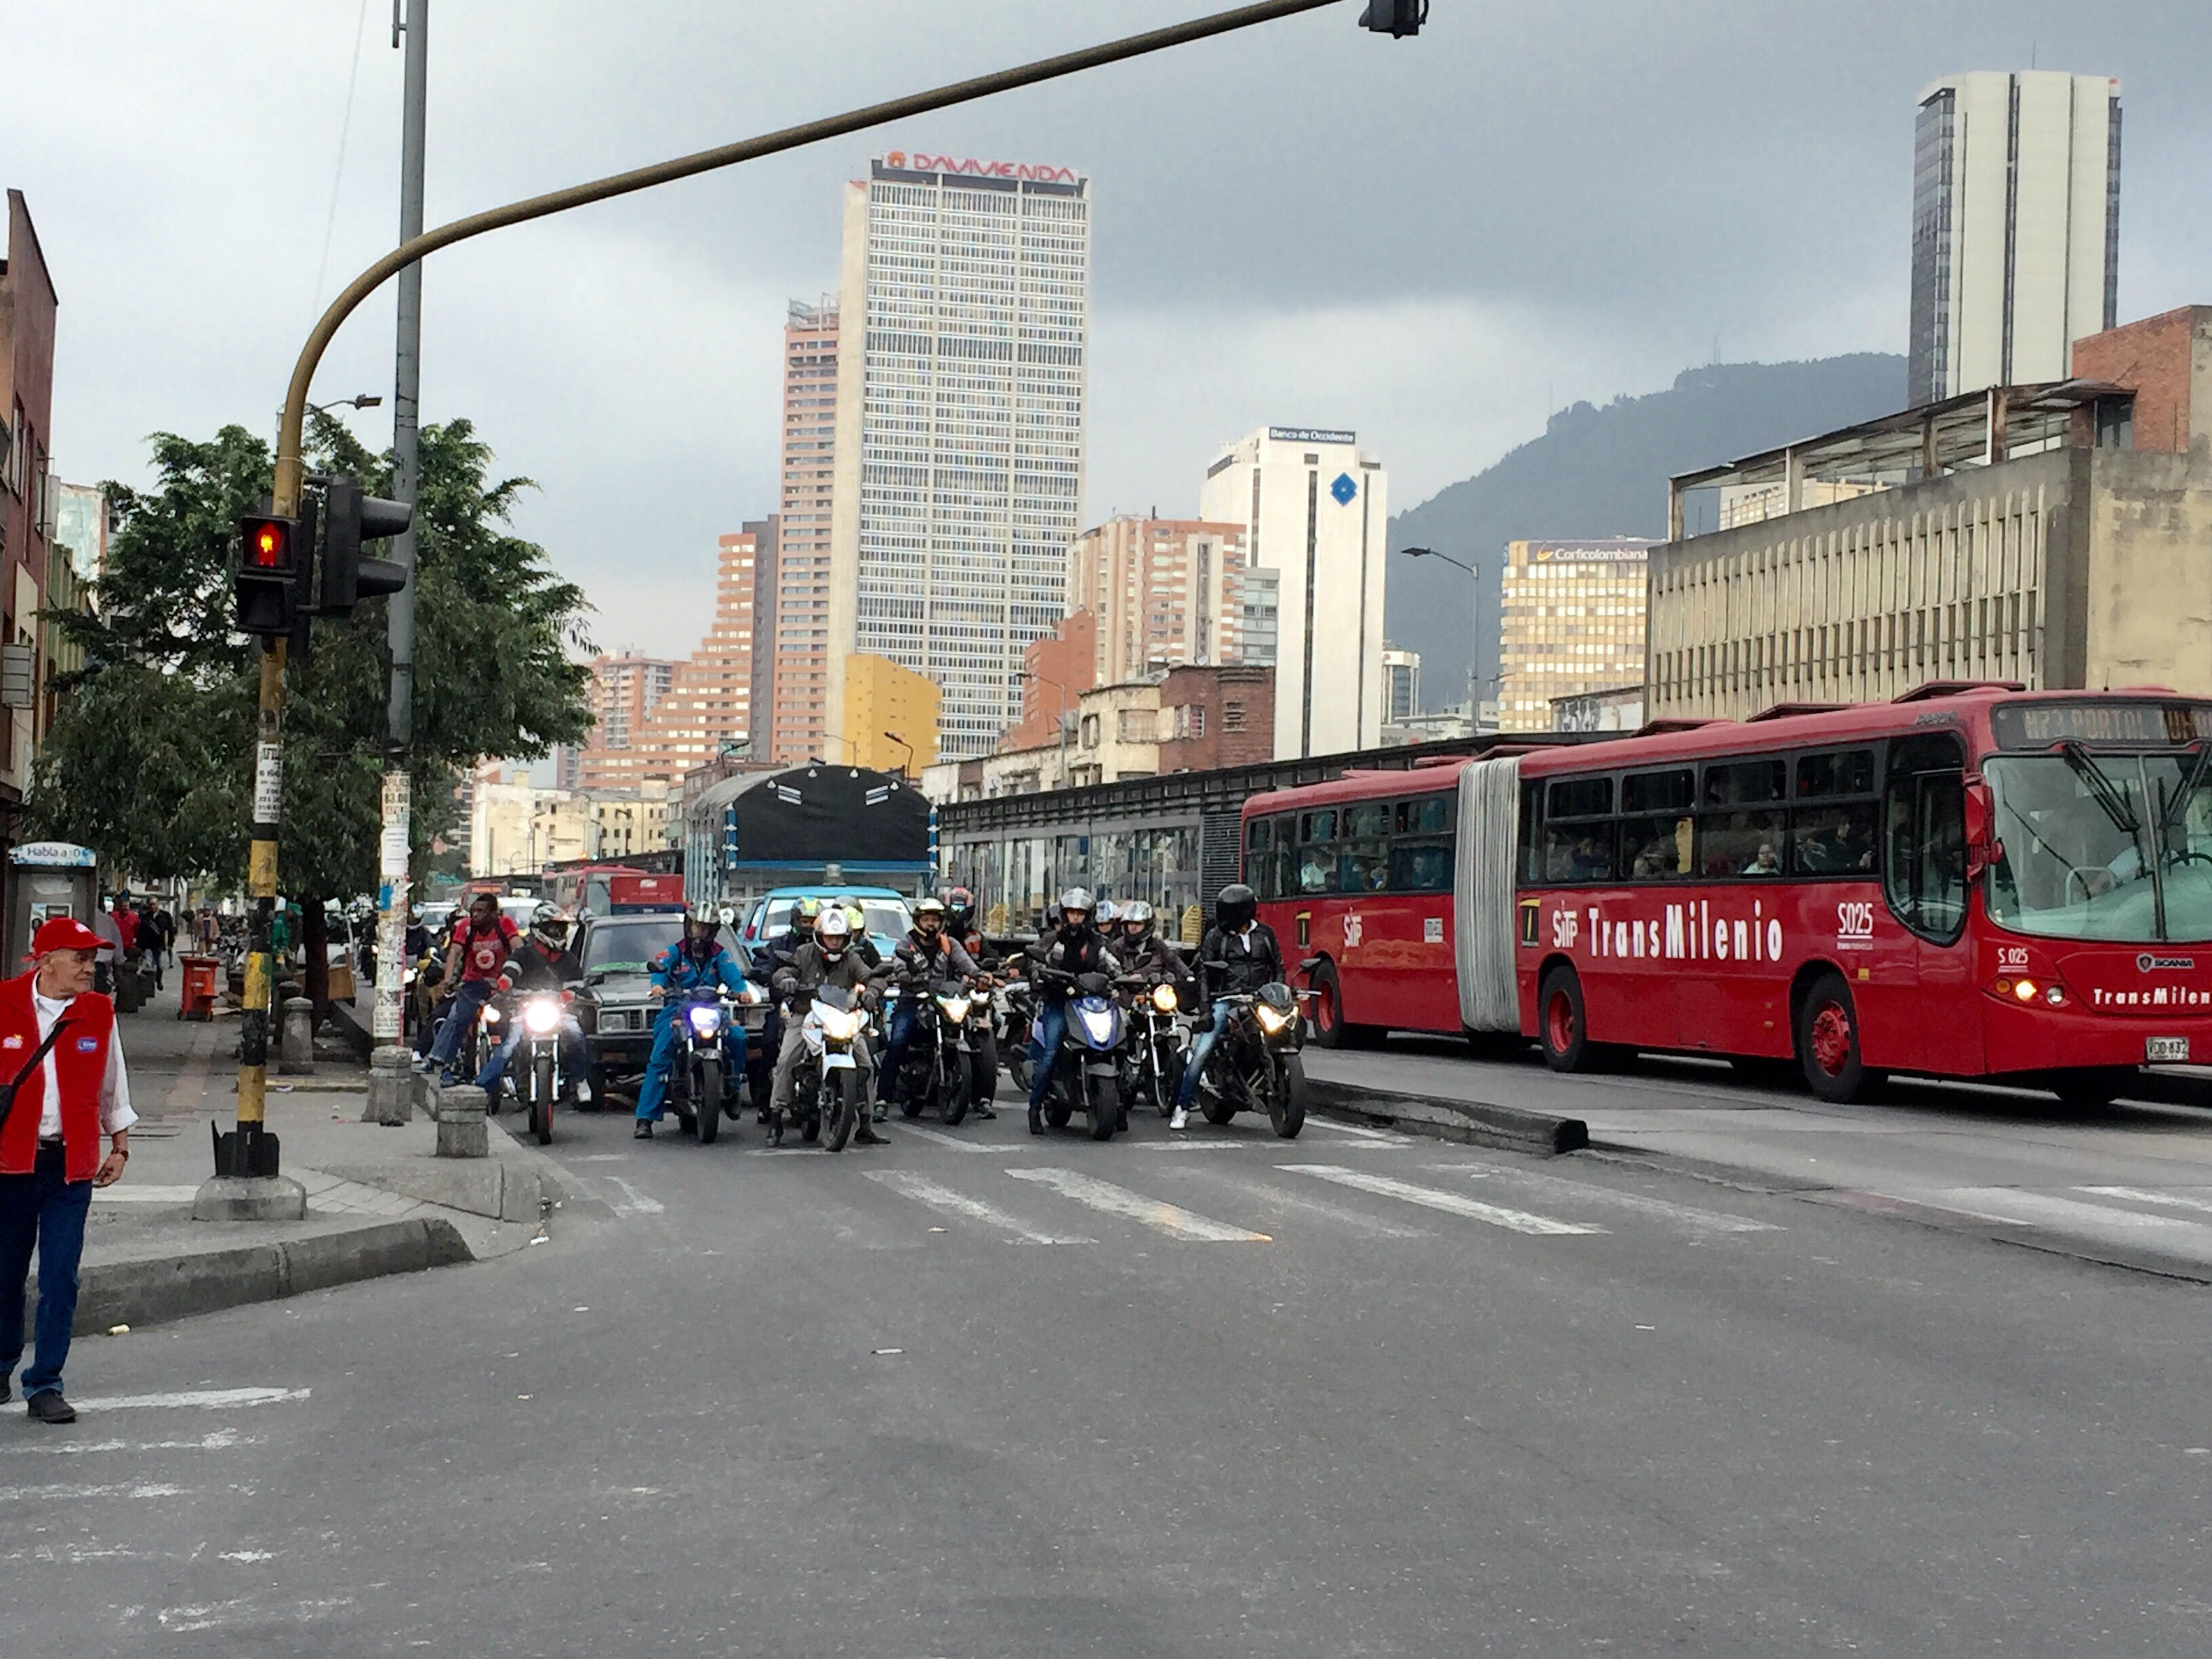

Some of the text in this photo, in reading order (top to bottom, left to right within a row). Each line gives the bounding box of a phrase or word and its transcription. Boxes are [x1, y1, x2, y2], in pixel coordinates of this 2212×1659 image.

[913, 153, 1076, 183] DAVIVIENDA
[1270, 428, 1354, 443] Banco de Occidente
[1554, 548, 1648, 560] Corficolombiana
[1588, 899, 1783, 962] TransMilenio
[1837, 902, 1874, 935] S025
